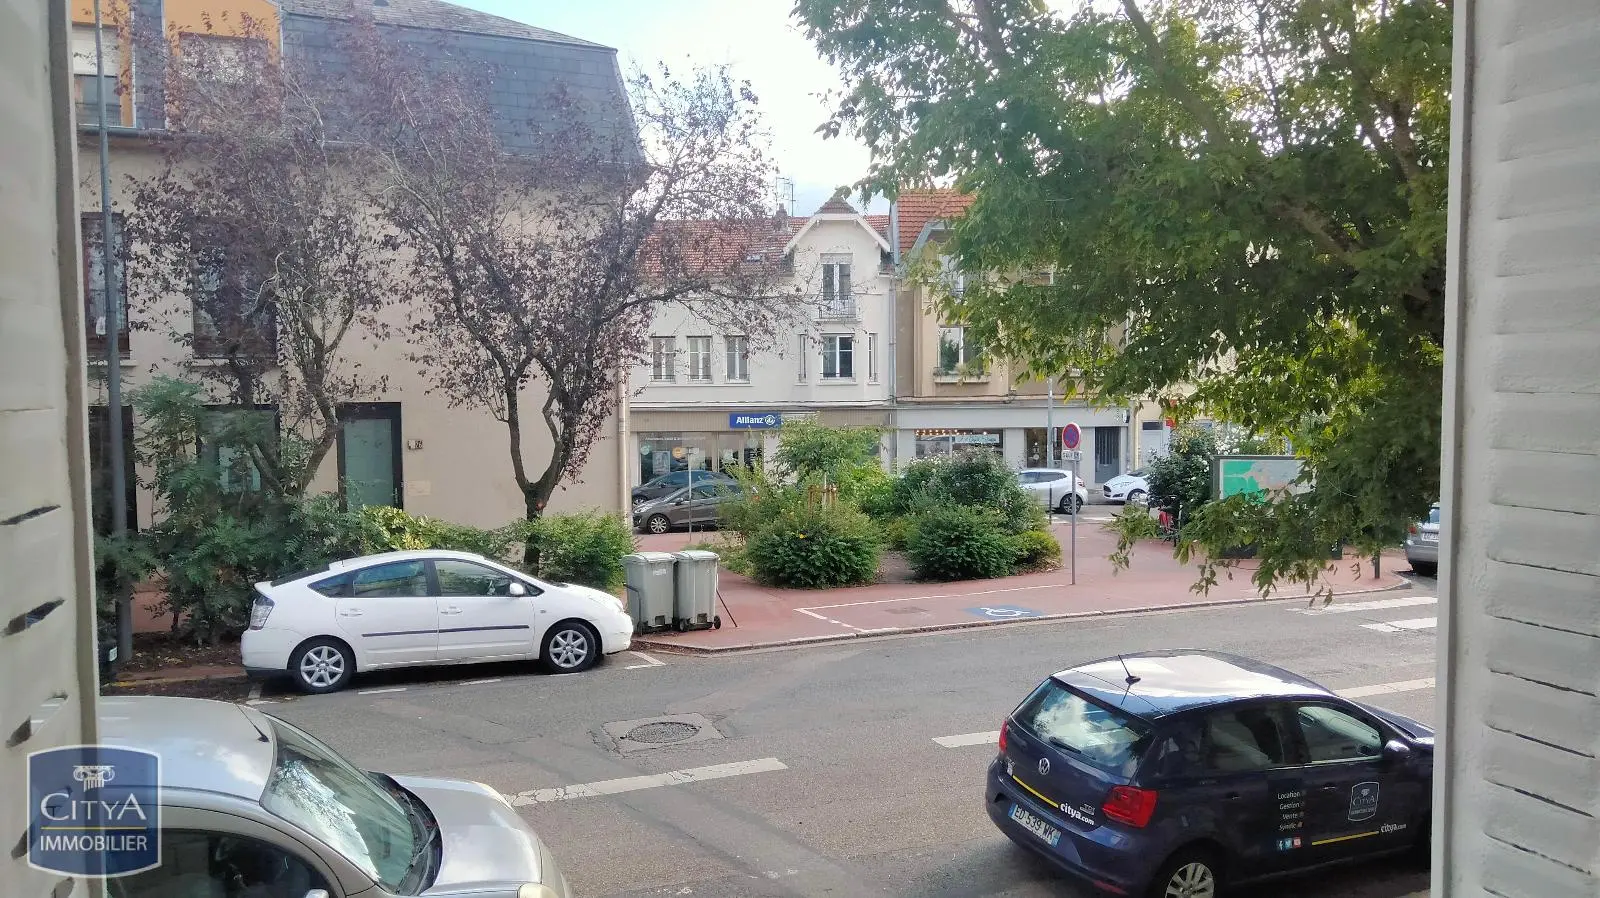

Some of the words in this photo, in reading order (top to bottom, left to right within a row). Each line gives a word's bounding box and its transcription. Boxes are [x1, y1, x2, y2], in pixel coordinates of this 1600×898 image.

[736, 416, 764, 424] Allianz
[1277, 790, 1300, 800] Location
[1279, 802, 1300, 810] Gestion
[1060, 803, 1095, 826] citya.com
[1380, 823, 1407, 833] citya.com
